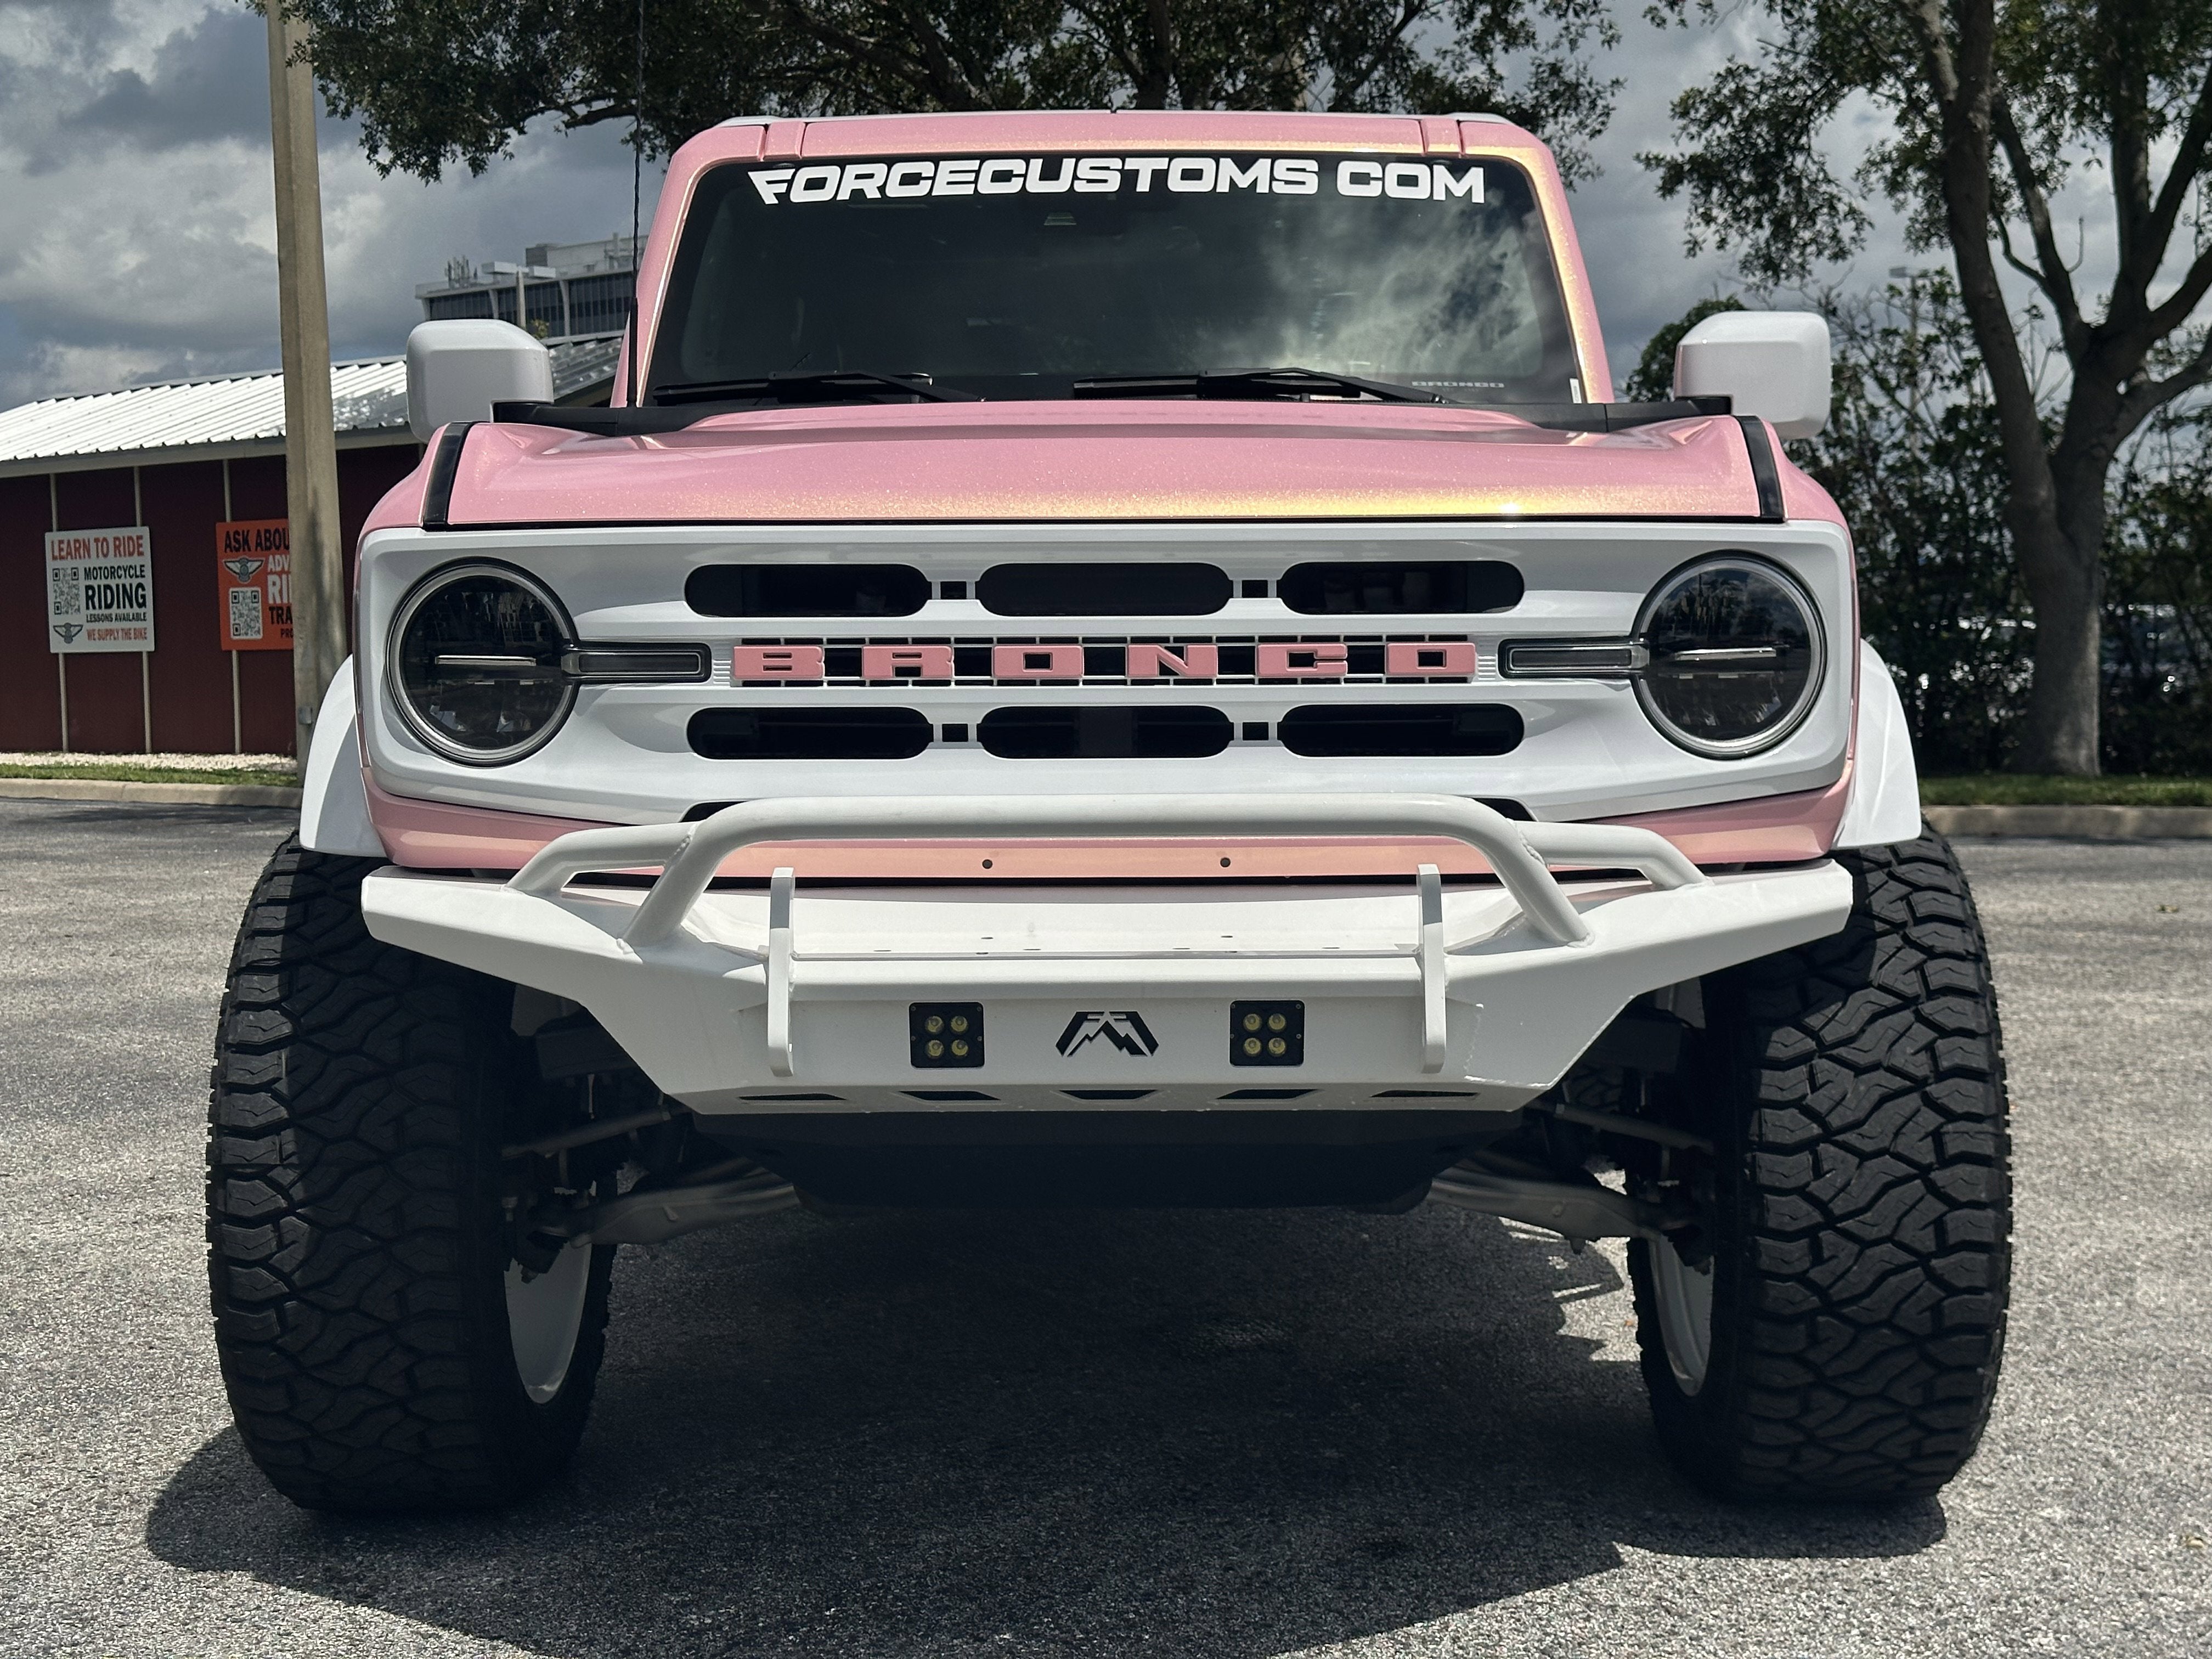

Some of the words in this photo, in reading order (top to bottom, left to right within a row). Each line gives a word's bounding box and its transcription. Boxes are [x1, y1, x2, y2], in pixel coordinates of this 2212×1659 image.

[748, 157, 1319, 205] FORCECUSTOMS
[1336, 161, 1485, 204] COM
[51, 538, 91, 561] LEARN
[94, 537, 109, 558] TO
[113, 535, 144, 558] RIDE
[224, 529, 251, 553] ASK
[255, 527, 290, 551] ABOU
[84, 565, 145, 580] MOTORCYCLE
[85, 582, 146, 611] RIDING
[86, 613, 113, 623] LESSONS
[115, 612, 147, 622] AVAILABLE
[87, 629, 97, 641] WE
[98, 628, 120, 641] SUPPLY
[121, 628, 132, 640] THE
[134, 627, 147, 640] BIKE
[732, 644, 1477, 681] BRONCO
